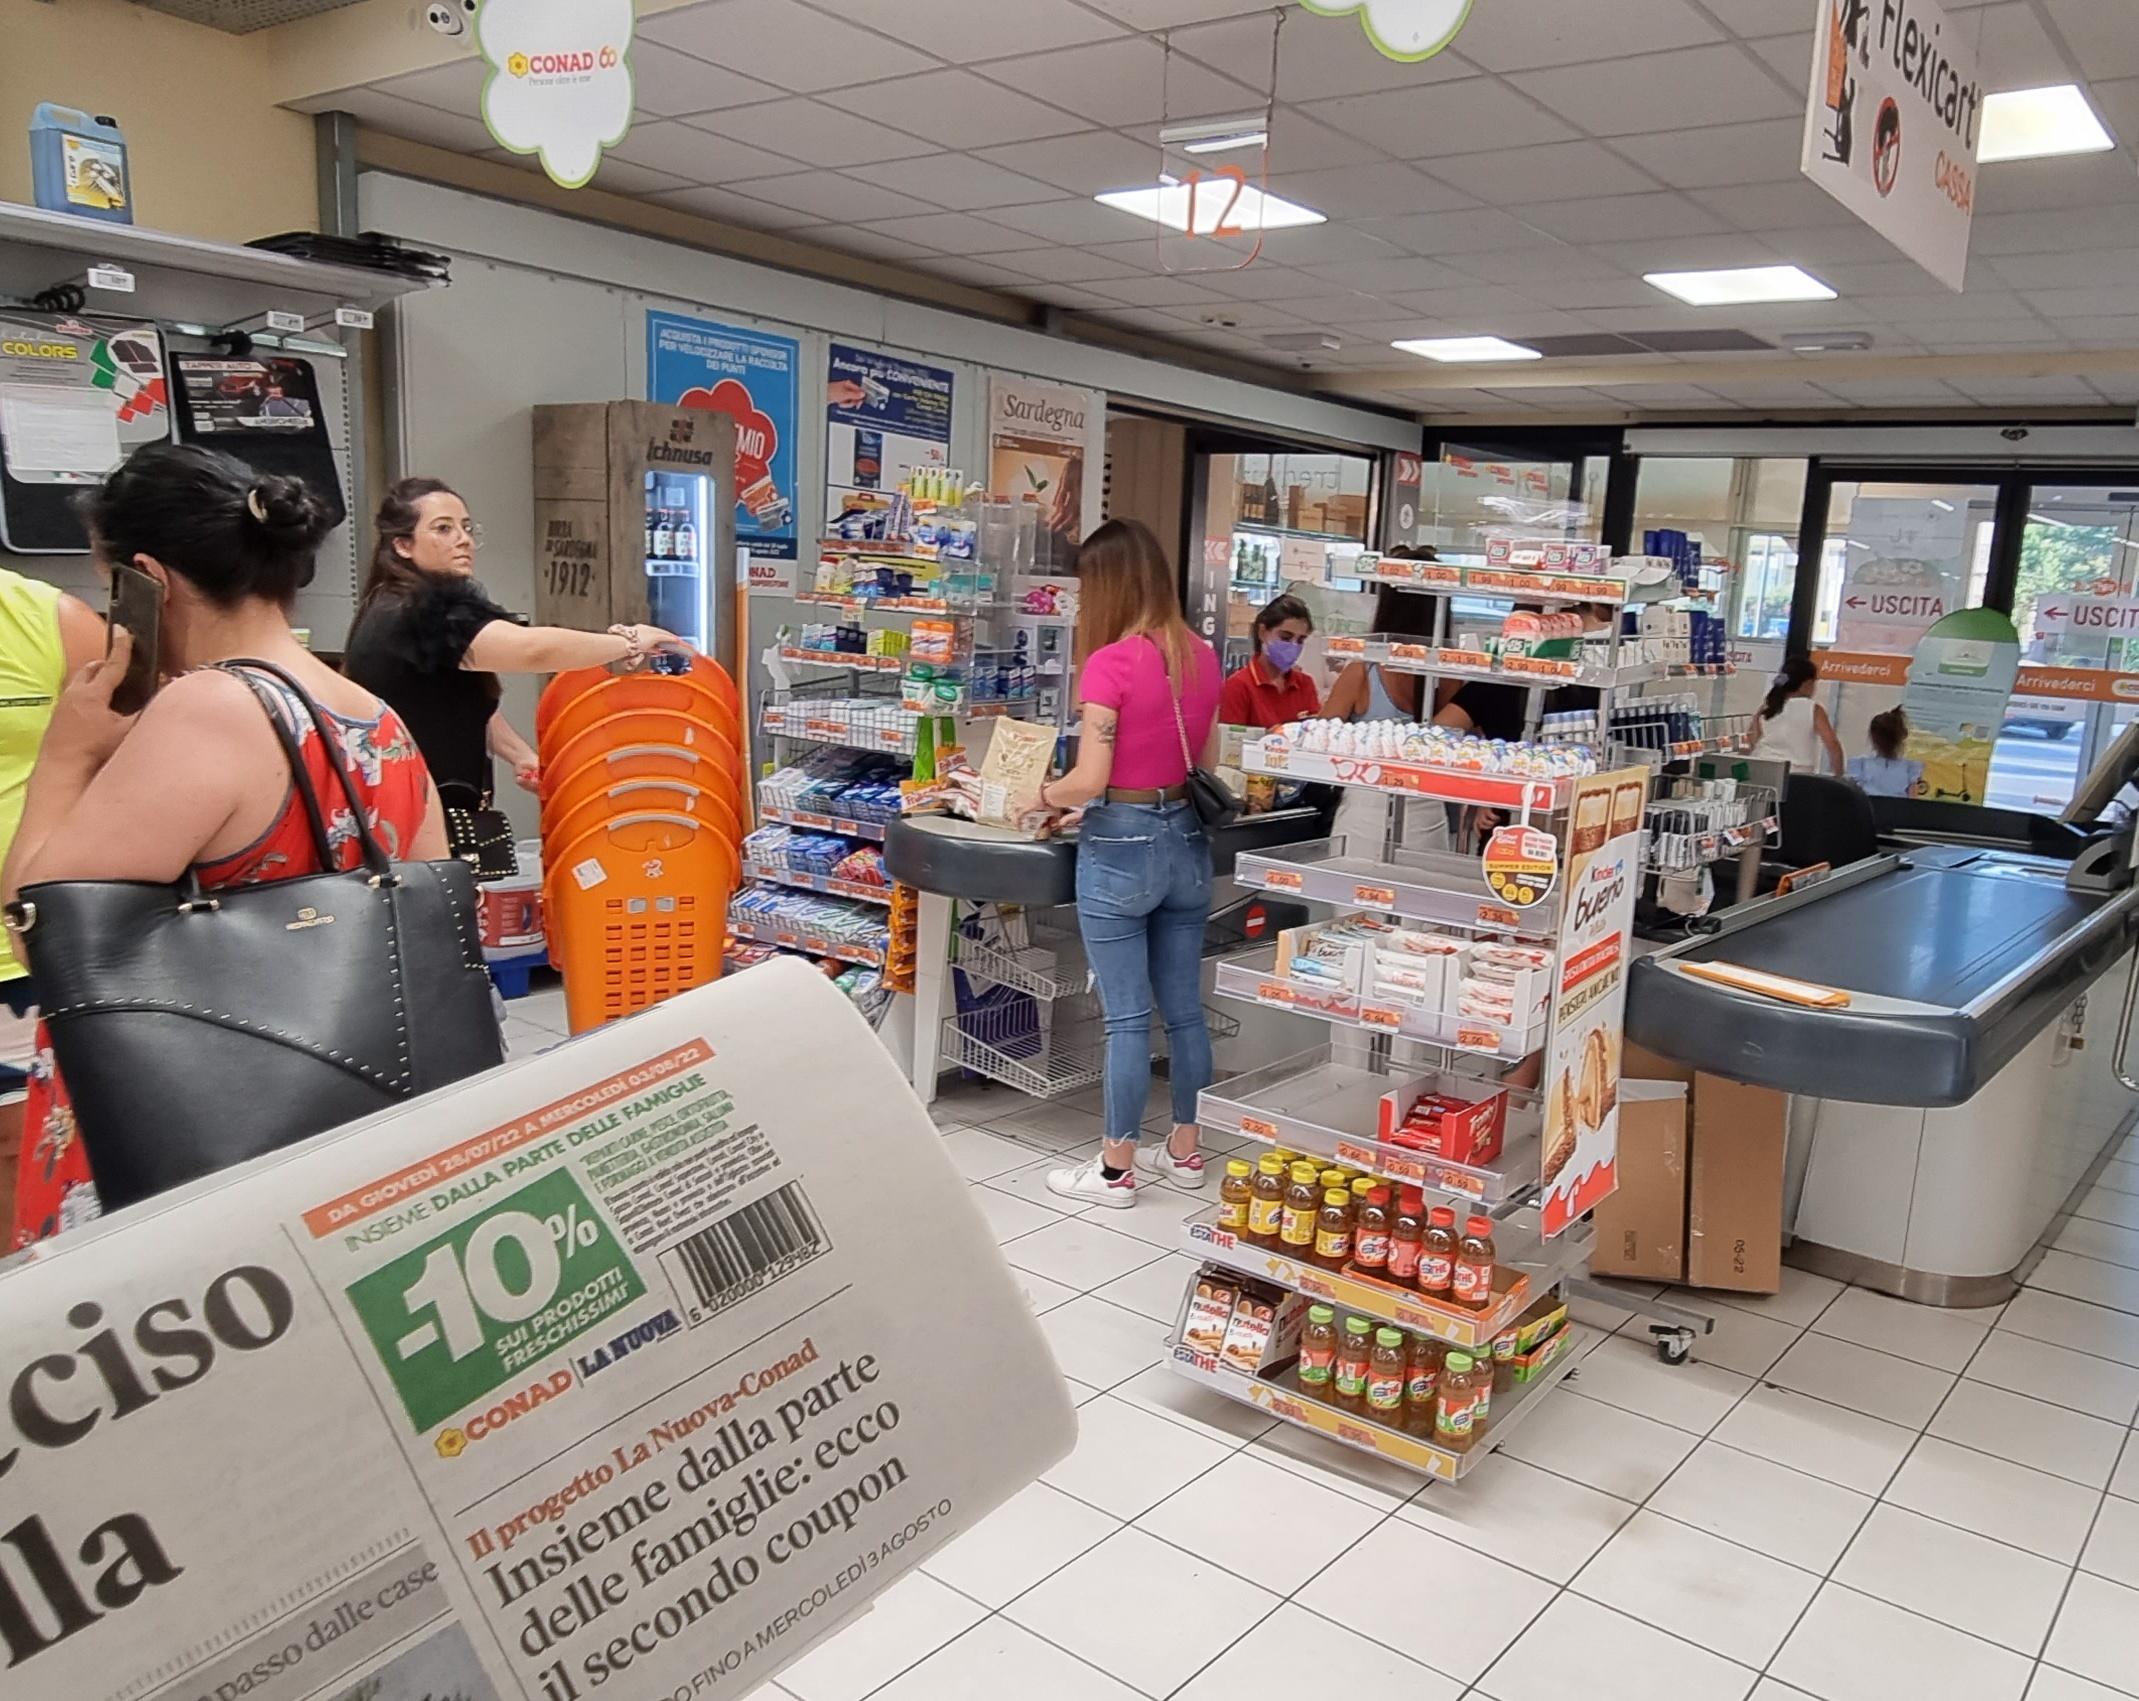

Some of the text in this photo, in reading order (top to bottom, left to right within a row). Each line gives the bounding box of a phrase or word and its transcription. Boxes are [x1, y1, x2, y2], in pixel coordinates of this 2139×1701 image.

[530, 52, 594, 74] CONAD
[1181, 163, 1246, 240] 12
[1935, 150, 1971, 216] CASSA
[2, 341, 78, 359] COLORS
[659, 339, 678, 351] PER
[735, 354, 747, 364] LA
[749, 356, 788, 372] RACCOLTA
[706, 360, 746, 375] DEI PUNTI
[1003, 394, 1086, 431] Sardegna
[1872, 595, 1944, 617] USCITA
[2074, 605, 2139, 629] USCIT
[1821, 661, 1892, 679] Arrivederci
[2016, 673, 2096, 693] Arrivederci
[1573, 876, 1625, 932] bueno
[328, 1205, 358, 1224] DA
[360, 1163, 439, 1207] GIOVEDÌ
[440, 1128, 522, 1173] 28/07/22
[523, 1122, 539, 1136] A
[540, 1078, 629, 1127] MERCOLEDÌ
[344, 1073, 707, 1253] INSIEME DALLA PARTE DELLE FAMIGLIE
[495, 1266, 624, 1356] SUI PRODOTTI
[502, 1283, 630, 1374] FRESCHISSIMI
[689, 1307, 701, 1323] 6
[1193, 1301, 1229, 1319] nutella
[1232, 1316, 1270, 1337] nutella
[0, 1265, 294, 1478] ciso
[465, 1308, 682, 1442] CONAD LA NUOVA
[466, 1336, 820, 1563] Il progetto La Nuova-Conad
[483, 1354, 880, 1609] Insieme dalla parte
[520, 1401, 900, 1657] delle famiglie: ecco
[538, 1456, 910, 1701] il secondo coupon
[691, 1650, 741, 1695] FINO
[743, 1640, 756, 1660] A
[755, 1561, 868, 1650] MERCOLEDÌ
[867, 1550, 881, 1568] 3
[880, 1498, 953, 1560] AGOSTO
[215, 1560, 440, 1701] passo dalle case
